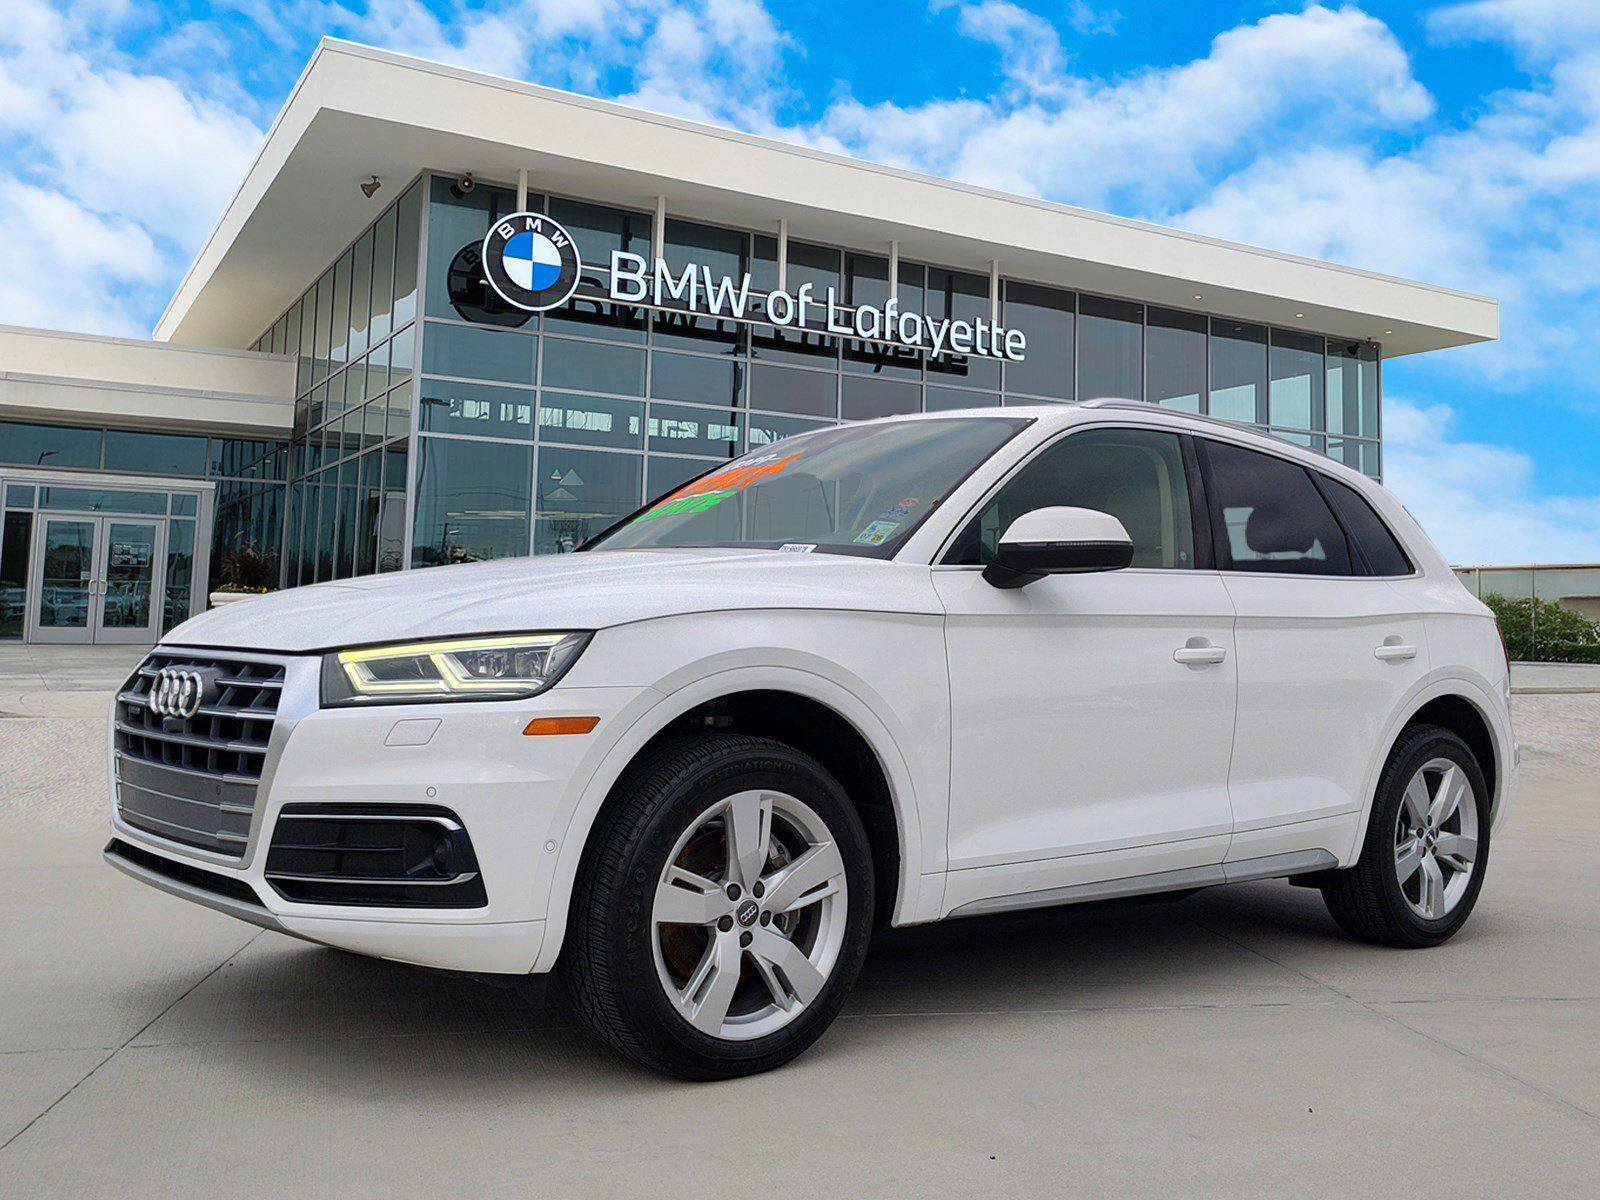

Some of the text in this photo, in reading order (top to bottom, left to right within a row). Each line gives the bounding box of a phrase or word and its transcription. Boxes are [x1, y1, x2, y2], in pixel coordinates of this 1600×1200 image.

[497, 217, 569, 248] BMW
[610, 250, 1026, 361] BMW of Lafayette
